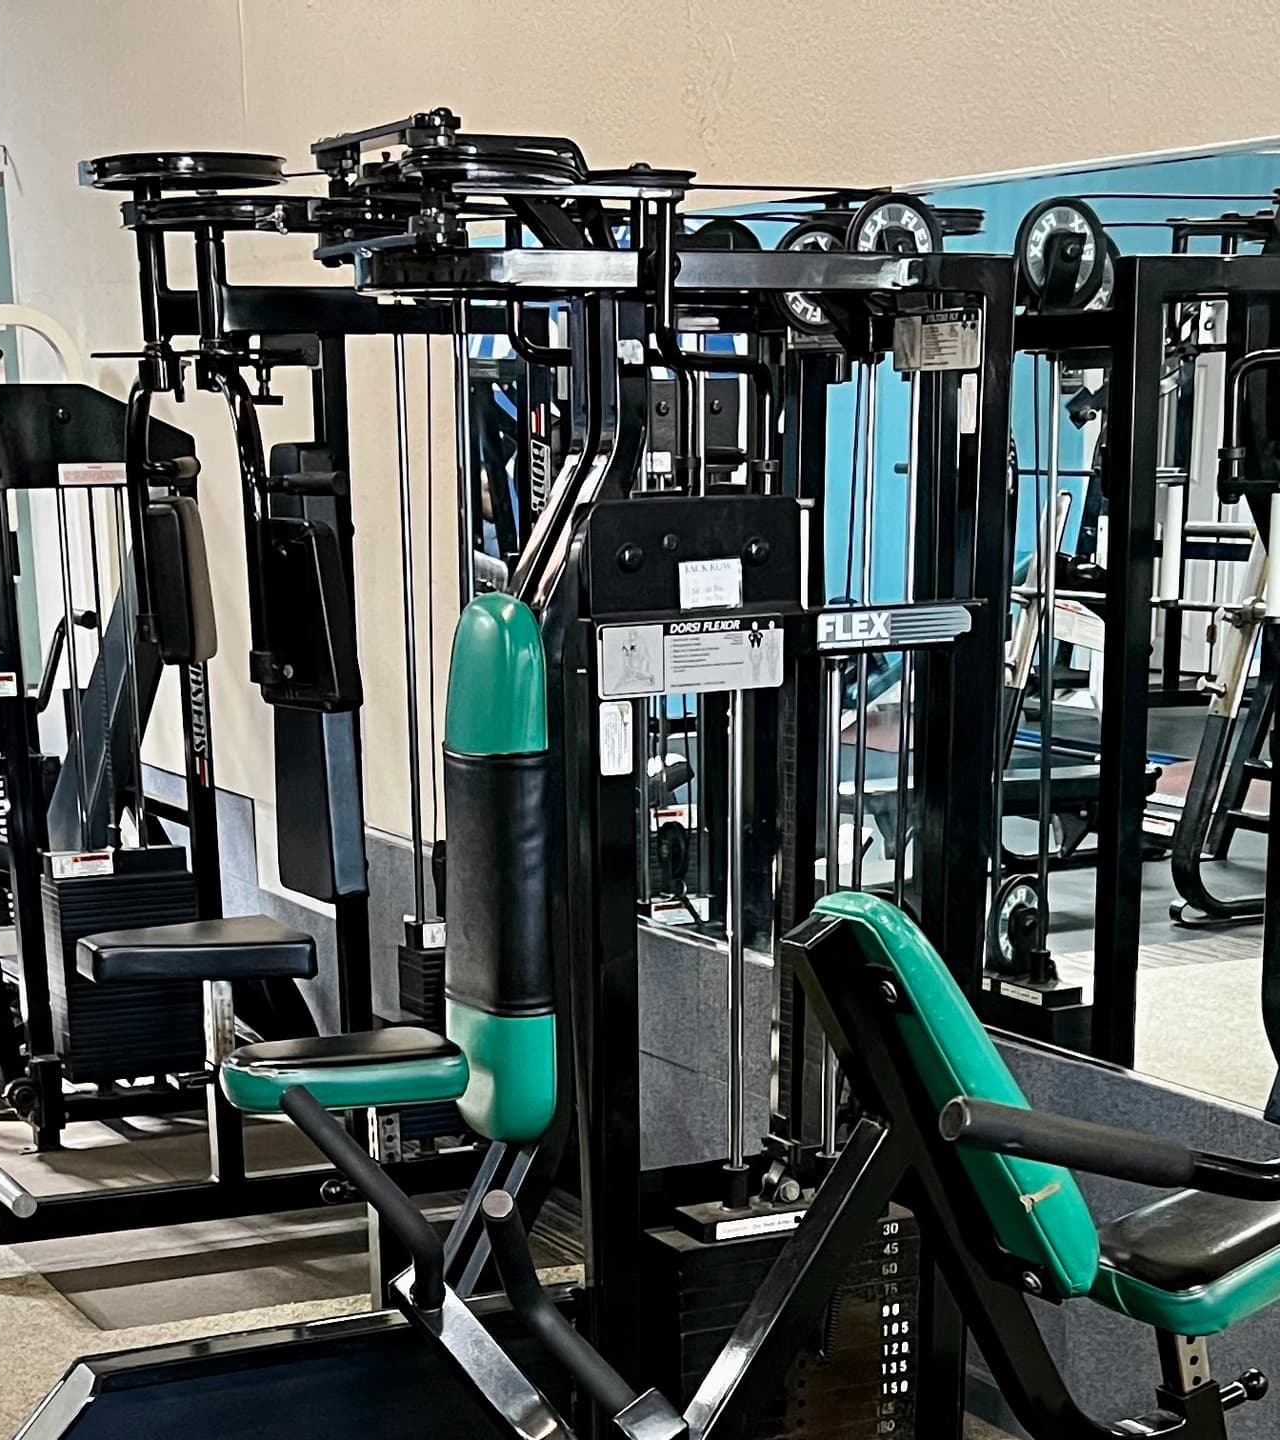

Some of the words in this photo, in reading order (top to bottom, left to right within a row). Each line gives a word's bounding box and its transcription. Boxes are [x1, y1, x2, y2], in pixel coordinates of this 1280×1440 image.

[670, 622, 701, 634] DORSI
[703, 619, 741, 632] FLEXOR
[819, 613, 890, 642] FLEX
[189, 662, 207, 752] ASTERS
[883, 1222, 899, 1236] 30
[883, 1242, 899, 1256] 45
[882, 1262, 898, 1276] 60
[882, 1303, 900, 1317] 90
[883, 1321, 909, 1336] 105
[883, 1341, 909, 1356] 120
[882, 1360, 907, 1375] 135
[882, 1380, 908, 1394] 150
